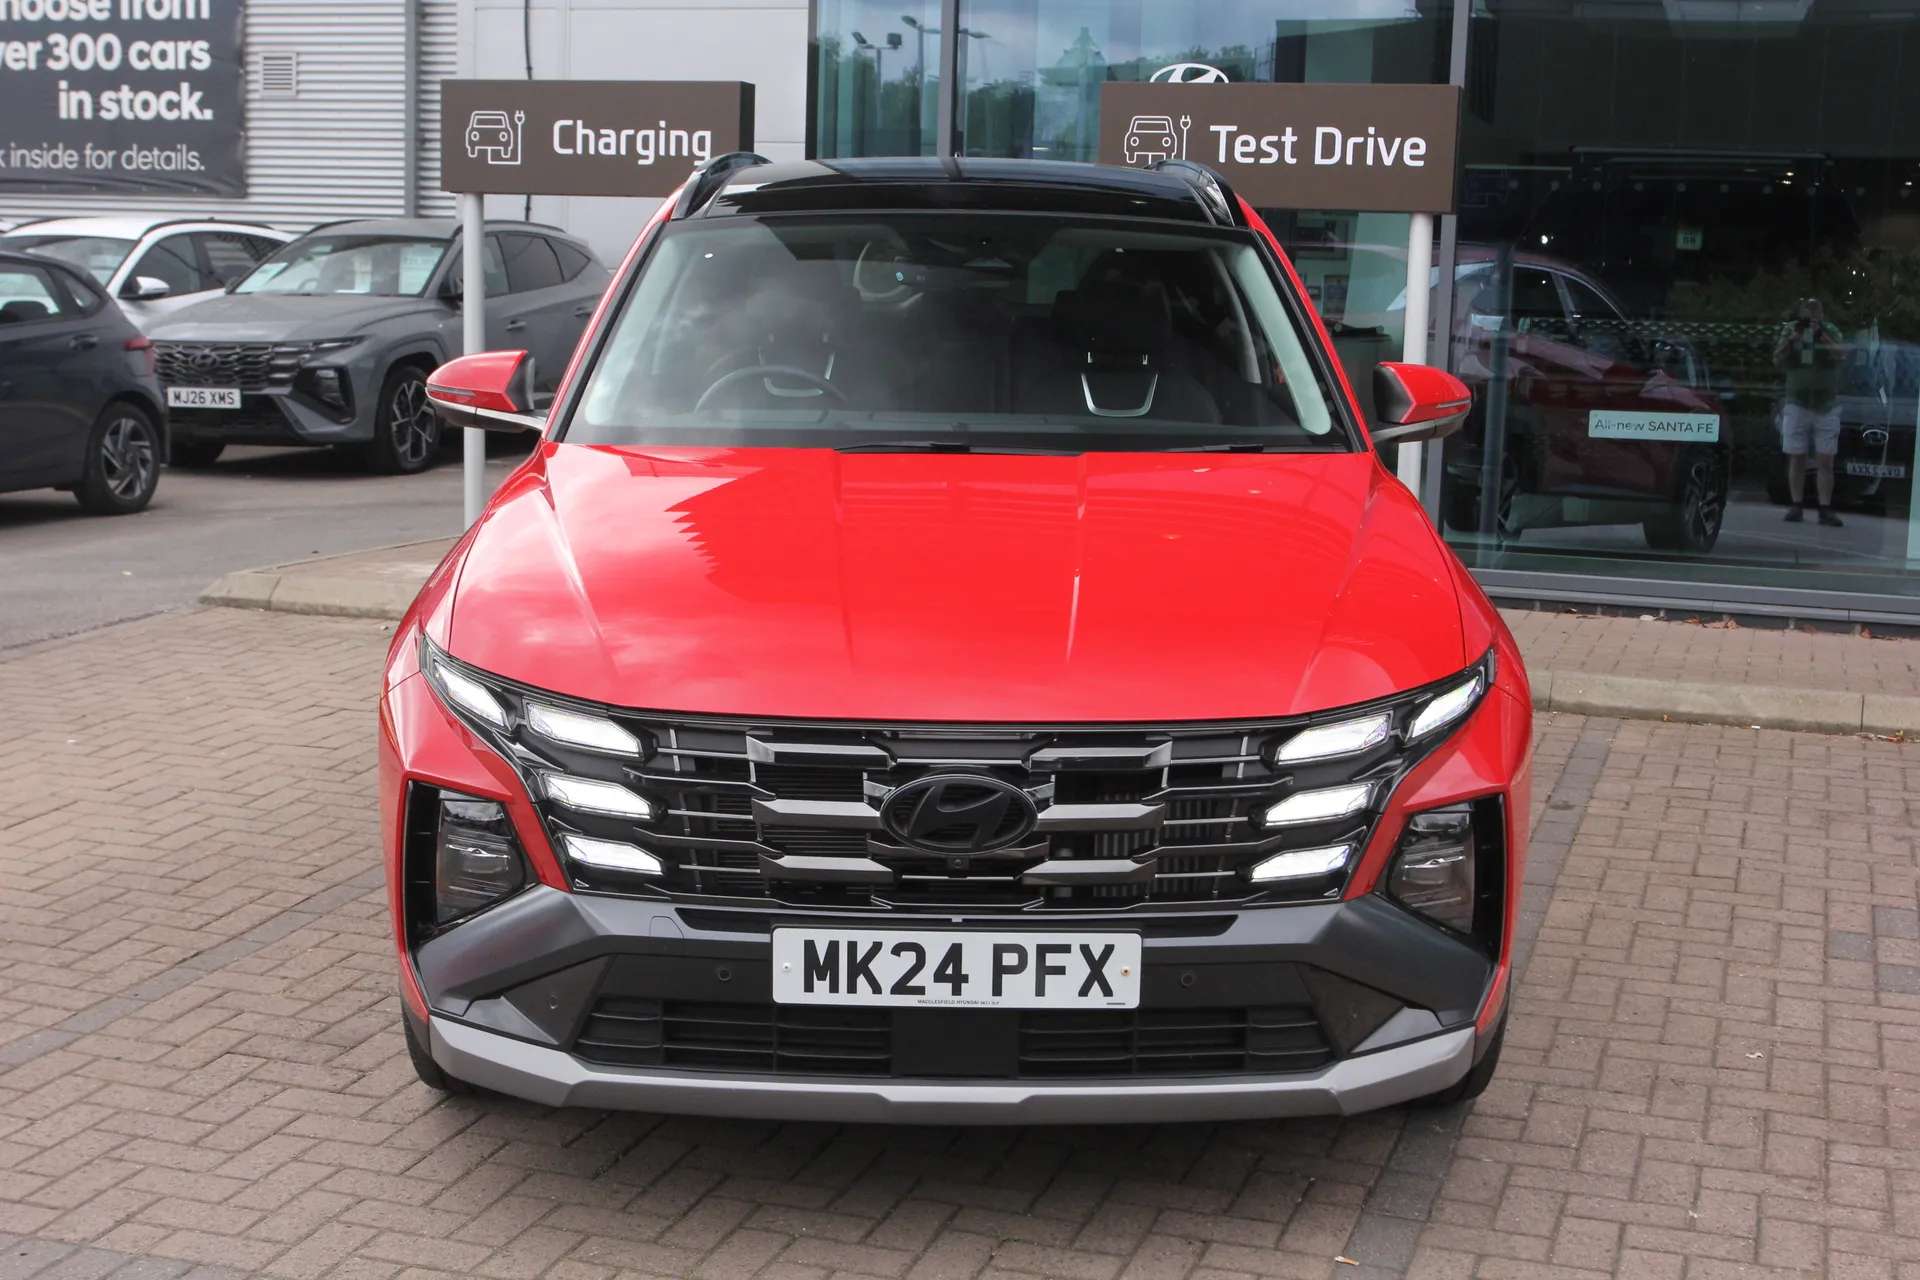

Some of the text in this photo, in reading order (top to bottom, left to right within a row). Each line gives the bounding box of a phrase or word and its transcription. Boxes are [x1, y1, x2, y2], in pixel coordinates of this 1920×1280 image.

[0, 32, 212, 70] er 300 cars
[58, 80, 214, 120] in stock.
[10, 142, 79, 169] inside
[84, 142, 117, 169] for
[121, 143, 206, 170] details.
[553, 119, 712, 165] Charging
[1209, 125, 1428, 167] Test Drive
[173, 390, 206, 405] MJ26
[1595, 419, 1713, 433] All-new SANTA FE
[803, 939, 1116, 998] MK24 PFX
